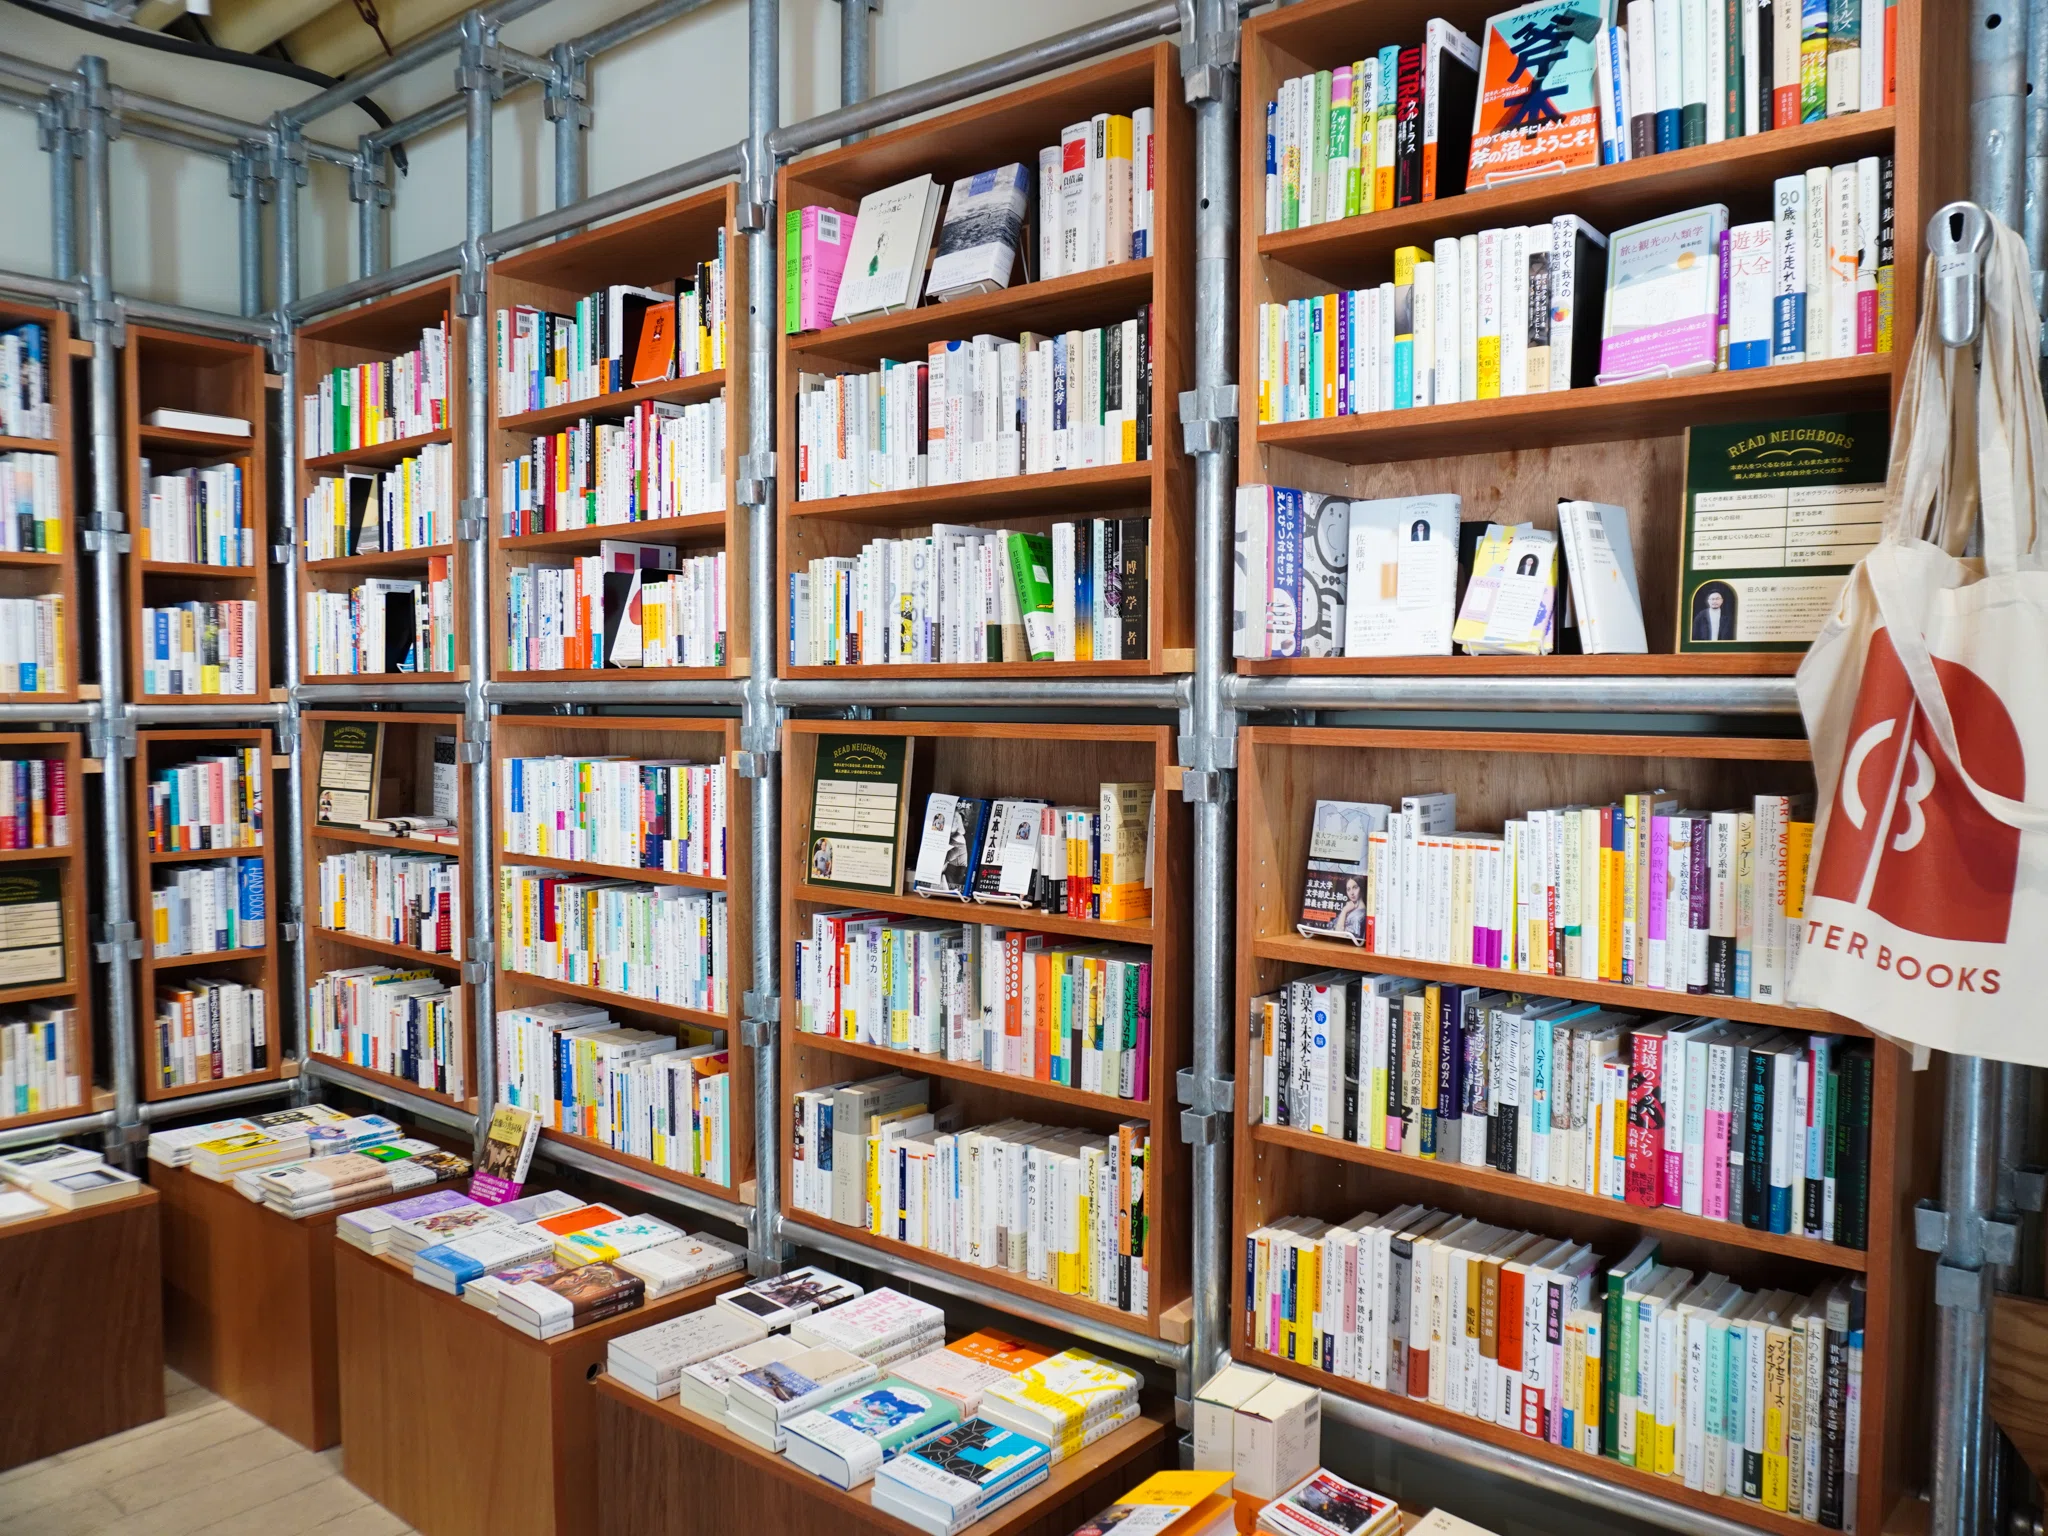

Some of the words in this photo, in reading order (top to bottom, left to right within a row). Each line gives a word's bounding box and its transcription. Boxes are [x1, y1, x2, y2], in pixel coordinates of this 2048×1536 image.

[1561, 219, 1573, 298] 失われゆく我々の
[1620, 226, 1704, 257] 旅と観光の人類学
[1731, 227, 1772, 251] 遊歩
[1731, 255, 1772, 277] 大全
[1483, 234, 1494, 317] 道を見つける力
[1054, 364, 1065, 406] 性食考
[1727, 434, 1766, 458] READ
[1770, 428, 1855, 450] NEIGHBORS
[985, 803, 1003, 864] 岡本太郎
[1102, 793, 1111, 843] 坂の上の雲
[1779, 796, 1789, 824] ART
[1777, 833, 1788, 906] WORKERS
[1877, 944, 2002, 996] BOOKS
[1410, 1011, 1423, 1106] 音楽雑誌と政治の季節
[1441, 1003, 1452, 1089] ニーナ・シモンのガム
[1639, 1039, 1658, 1158] 辺境のラッパーたち
[1752, 1056, 1767, 1134] ホラー映画の科学
[1028, 1160, 1036, 1206] 観察の力
[1357, 1236, 1366, 1345] ややこしい本を読む技術
